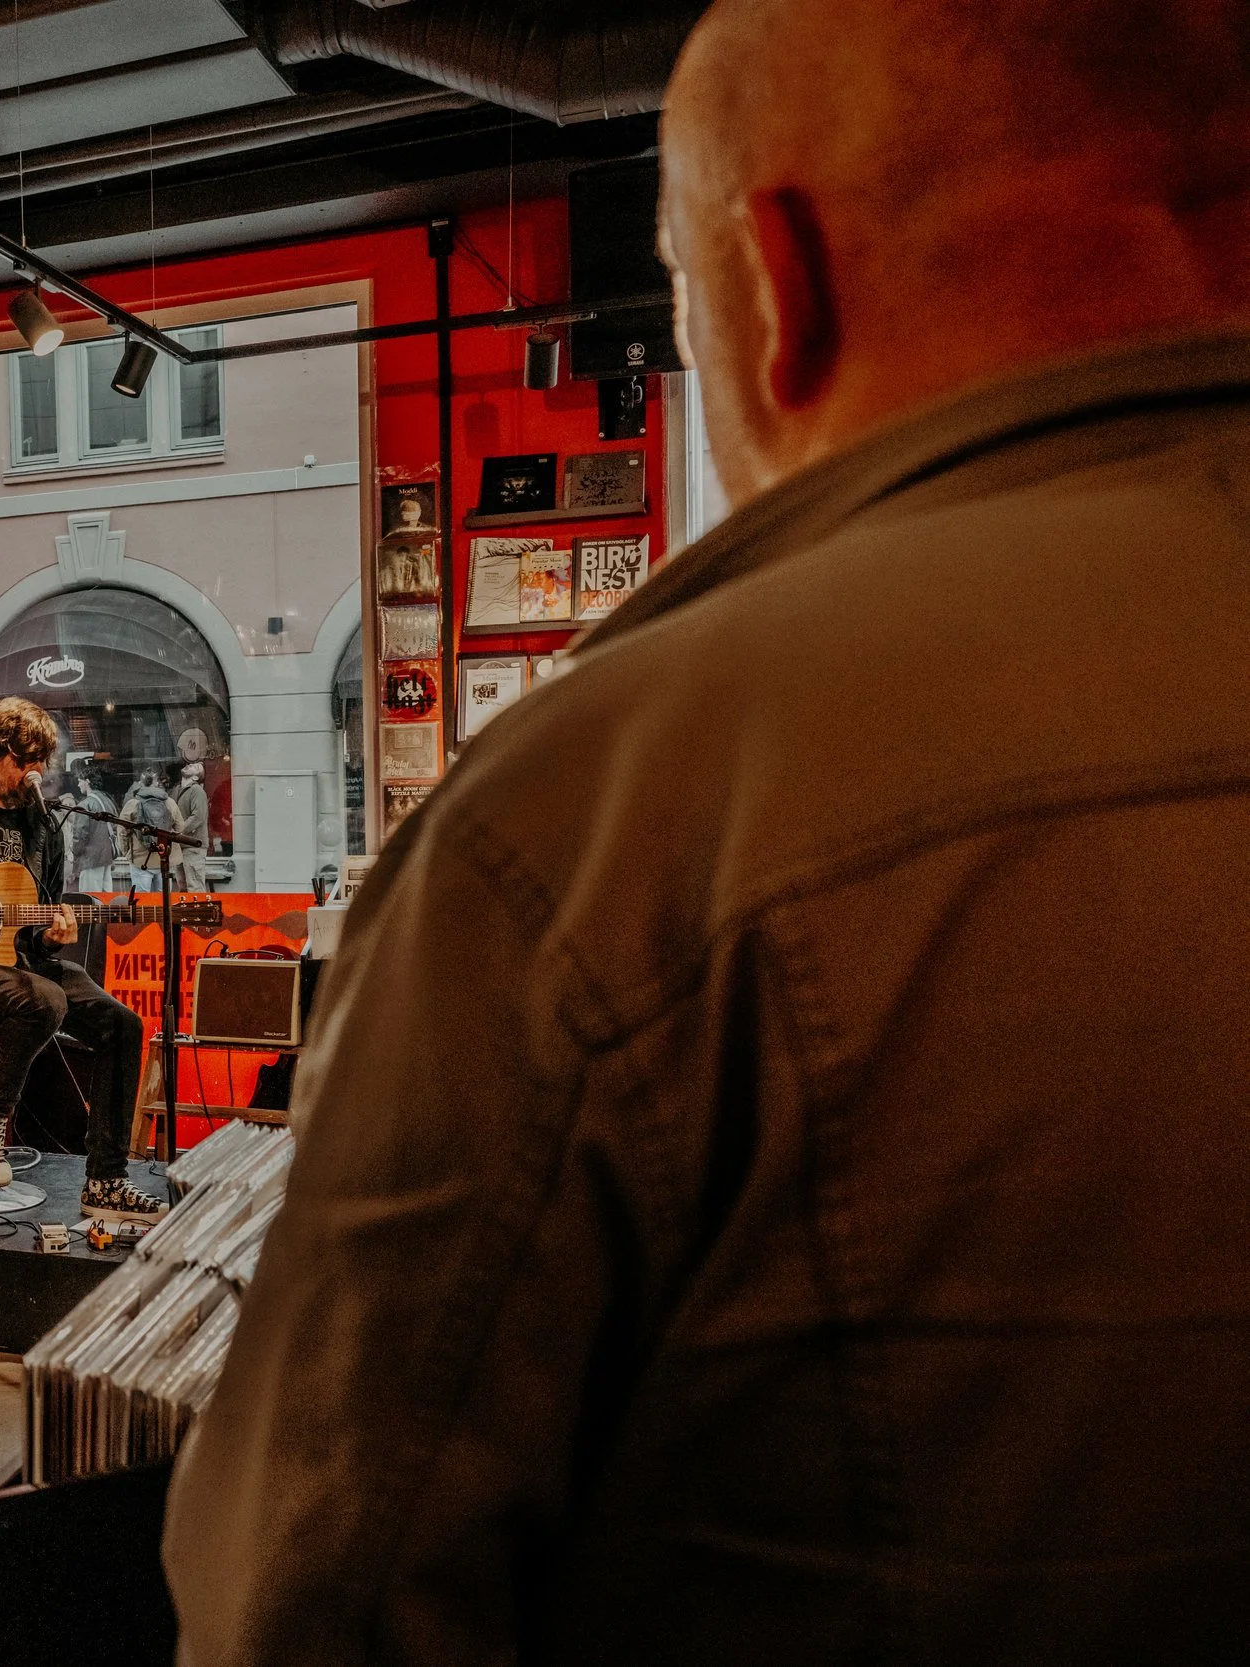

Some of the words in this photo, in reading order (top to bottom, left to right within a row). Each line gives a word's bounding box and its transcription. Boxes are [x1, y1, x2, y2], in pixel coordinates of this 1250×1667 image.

[627, 359, 645, 367] YAMAHA
[581, 545, 642, 570] BIRD
[580, 567, 640, 591] NEST
